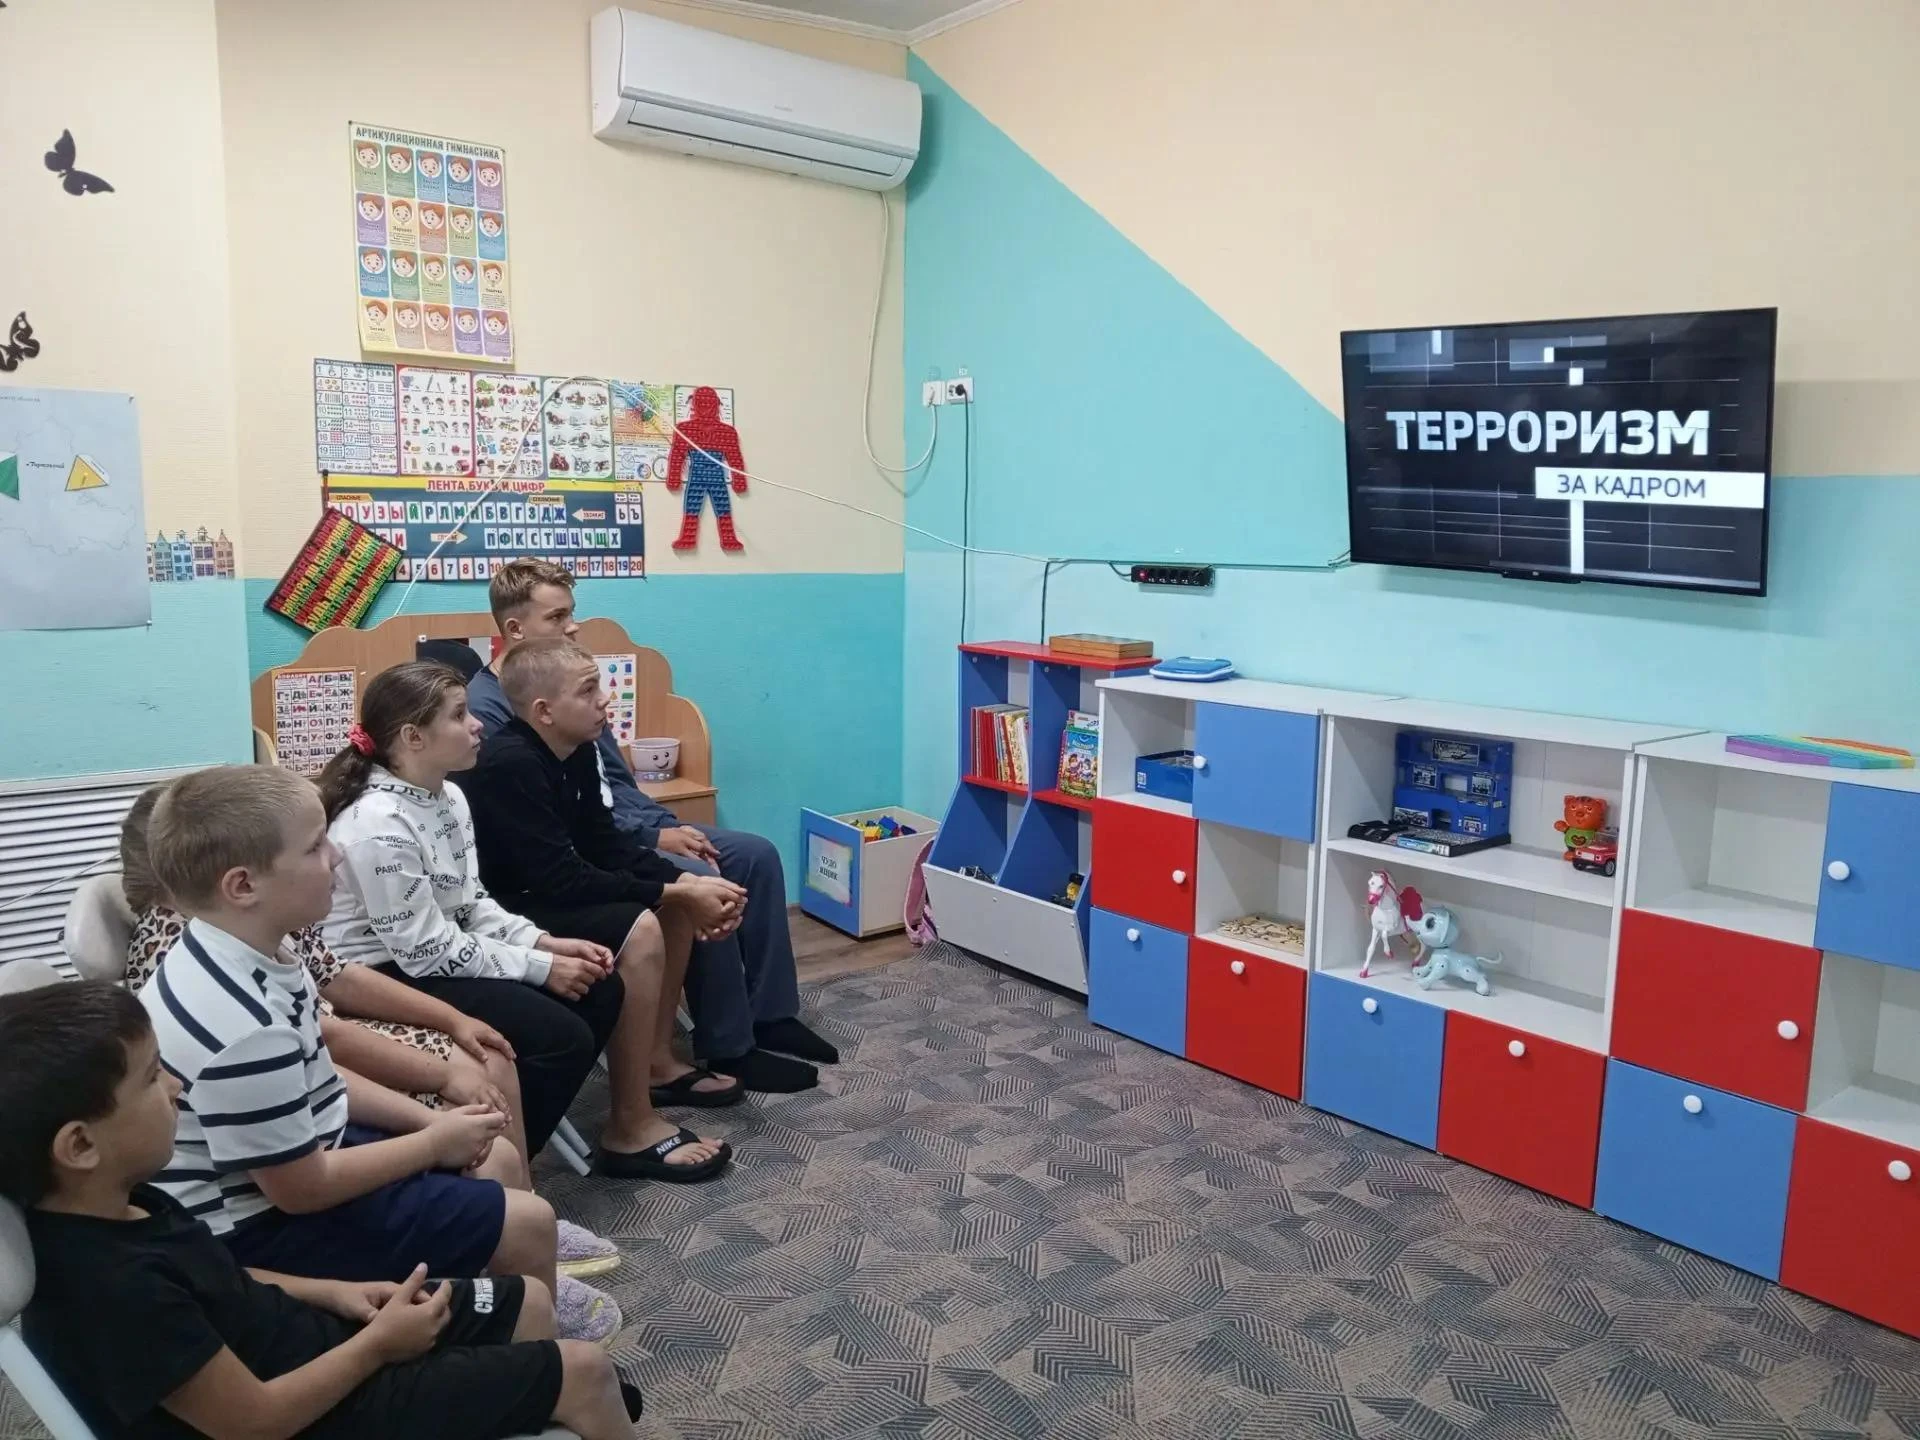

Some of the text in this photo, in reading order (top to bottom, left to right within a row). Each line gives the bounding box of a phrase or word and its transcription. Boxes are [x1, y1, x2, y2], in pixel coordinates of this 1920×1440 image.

[356, 127, 500, 160] АРТИКУЛЯЦИОННАЯ ГИМНАСТИКА
[1386, 409, 1710, 455] ТЕРРОРИЗМ
[1557, 474, 1707, 499] ЗА КАДРОМ
[362, 506, 371, 519] У
[390, 507, 404, 519] Ы
[426, 506, 434, 519] Р
[440, 507, 450, 519] Л
[455, 507, 466, 519] М
[486, 507, 494, 519] Б
[500, 507, 508, 519] В
[515, 507, 523, 519] Г
[541, 506, 552, 522] Д
[554, 507, 565, 520] Ж
[311, 516, 352, 566] СТОРОНАМ
[395, 533, 404, 546] И
[486, 532, 620, 548] П Ф К С Т Ш Ц Ч Щ Х
[398, 564, 406, 575] 4
[431, 564, 438, 575] 6
[446, 563, 454, 575] 7
[462, 563, 469, 575] 8
[477, 563, 484, 575] 9
[562, 561, 574, 571] 15
[576, 562, 588, 572] 16
[592, 562, 601, 571] 17
[604, 561, 615, 571] 18
[617, 561, 629, 571] 19
[631, 561, 642, 571] 20
[302, 596, 332, 630] БУДЬ
[320, 530, 377, 601] ВНИМАТЕЛЕН
[340, 689, 350, 697] Ж
[294, 720, 302, 728] Н
[326, 732, 334, 740] Ф
[310, 747, 320, 756] Ш
[375, 863, 403, 877] PARIS
[404, 878, 421, 901] PARIS
[656, 1136, 681, 1155] NIKE
